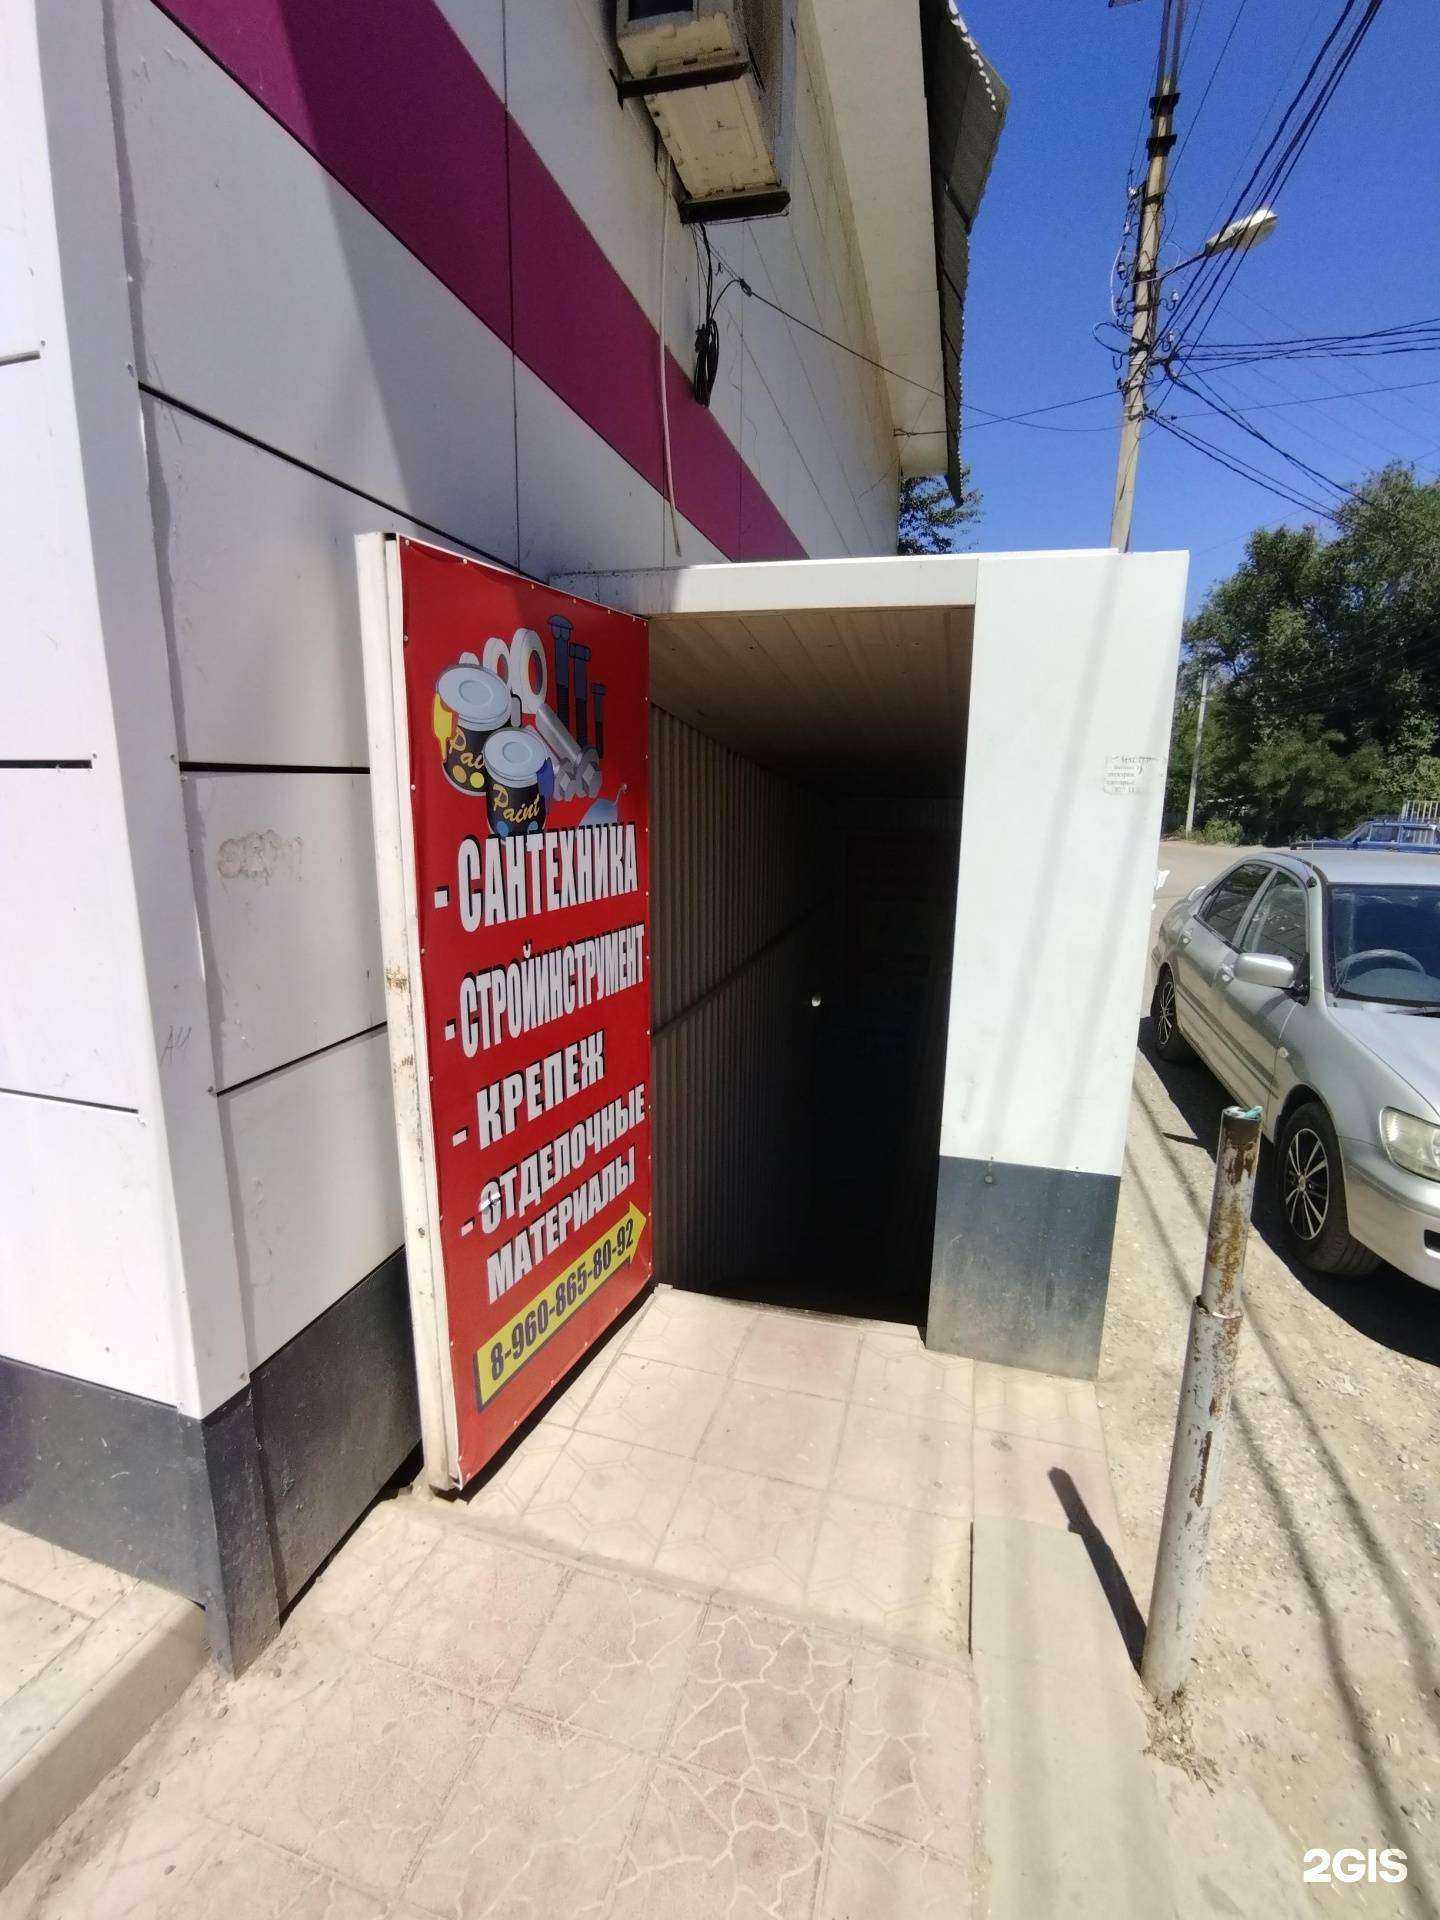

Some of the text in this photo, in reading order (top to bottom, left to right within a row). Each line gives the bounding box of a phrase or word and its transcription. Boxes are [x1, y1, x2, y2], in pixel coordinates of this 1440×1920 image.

[493, 784, 540, 823] Paint
[458, 823, 638, 932] САНТЕХНИКА
[459, 924, 645, 1058] СТРОЙИНСТРУМЕНТ
[476, 1031, 605, 1150] КРЕПЕЖ
[480, 1082, 646, 1235] ОТДЕЛОЧНЫЕ
[486, 1146, 636, 1305] МАТЕРИАЛЫ
[490, 1217, 634, 1381] 8-960-865-80-92
